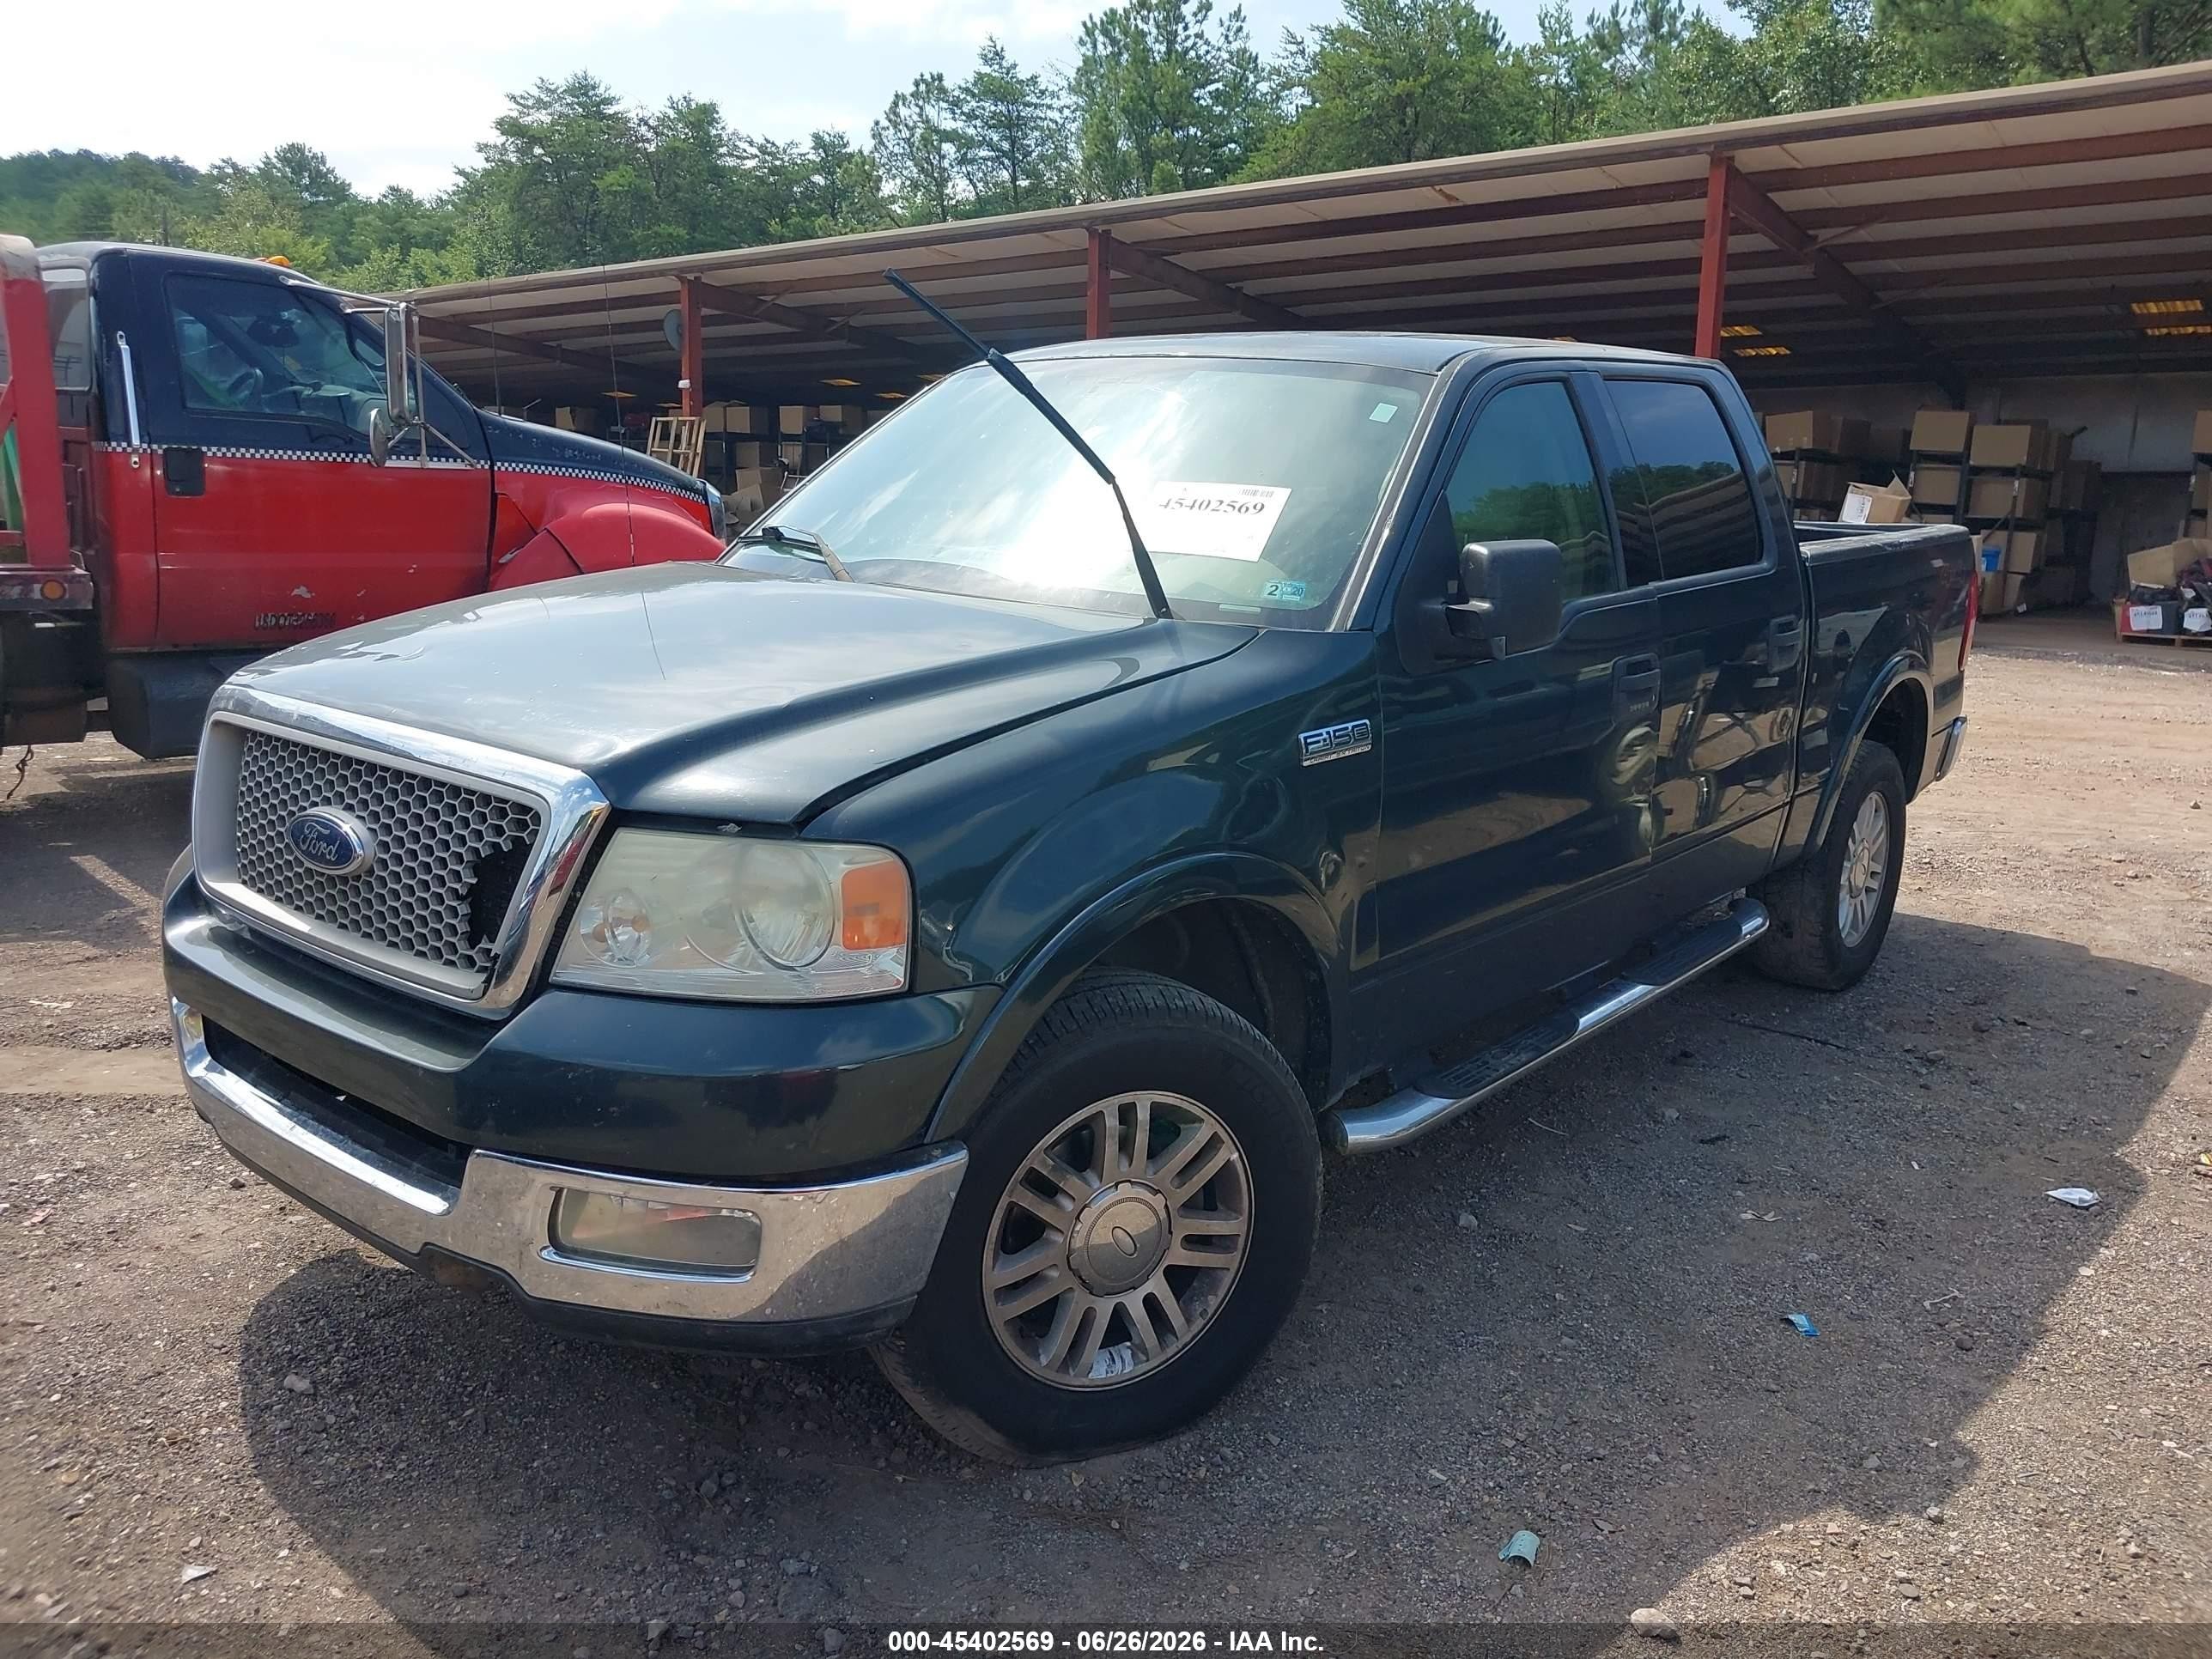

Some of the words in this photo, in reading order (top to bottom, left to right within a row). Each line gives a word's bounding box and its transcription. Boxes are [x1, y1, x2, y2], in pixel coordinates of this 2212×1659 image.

[1158, 497, 1266, 515] 45402569
[1267, 584, 1279, 596] 2
[300, 822, 340, 861] Ford
